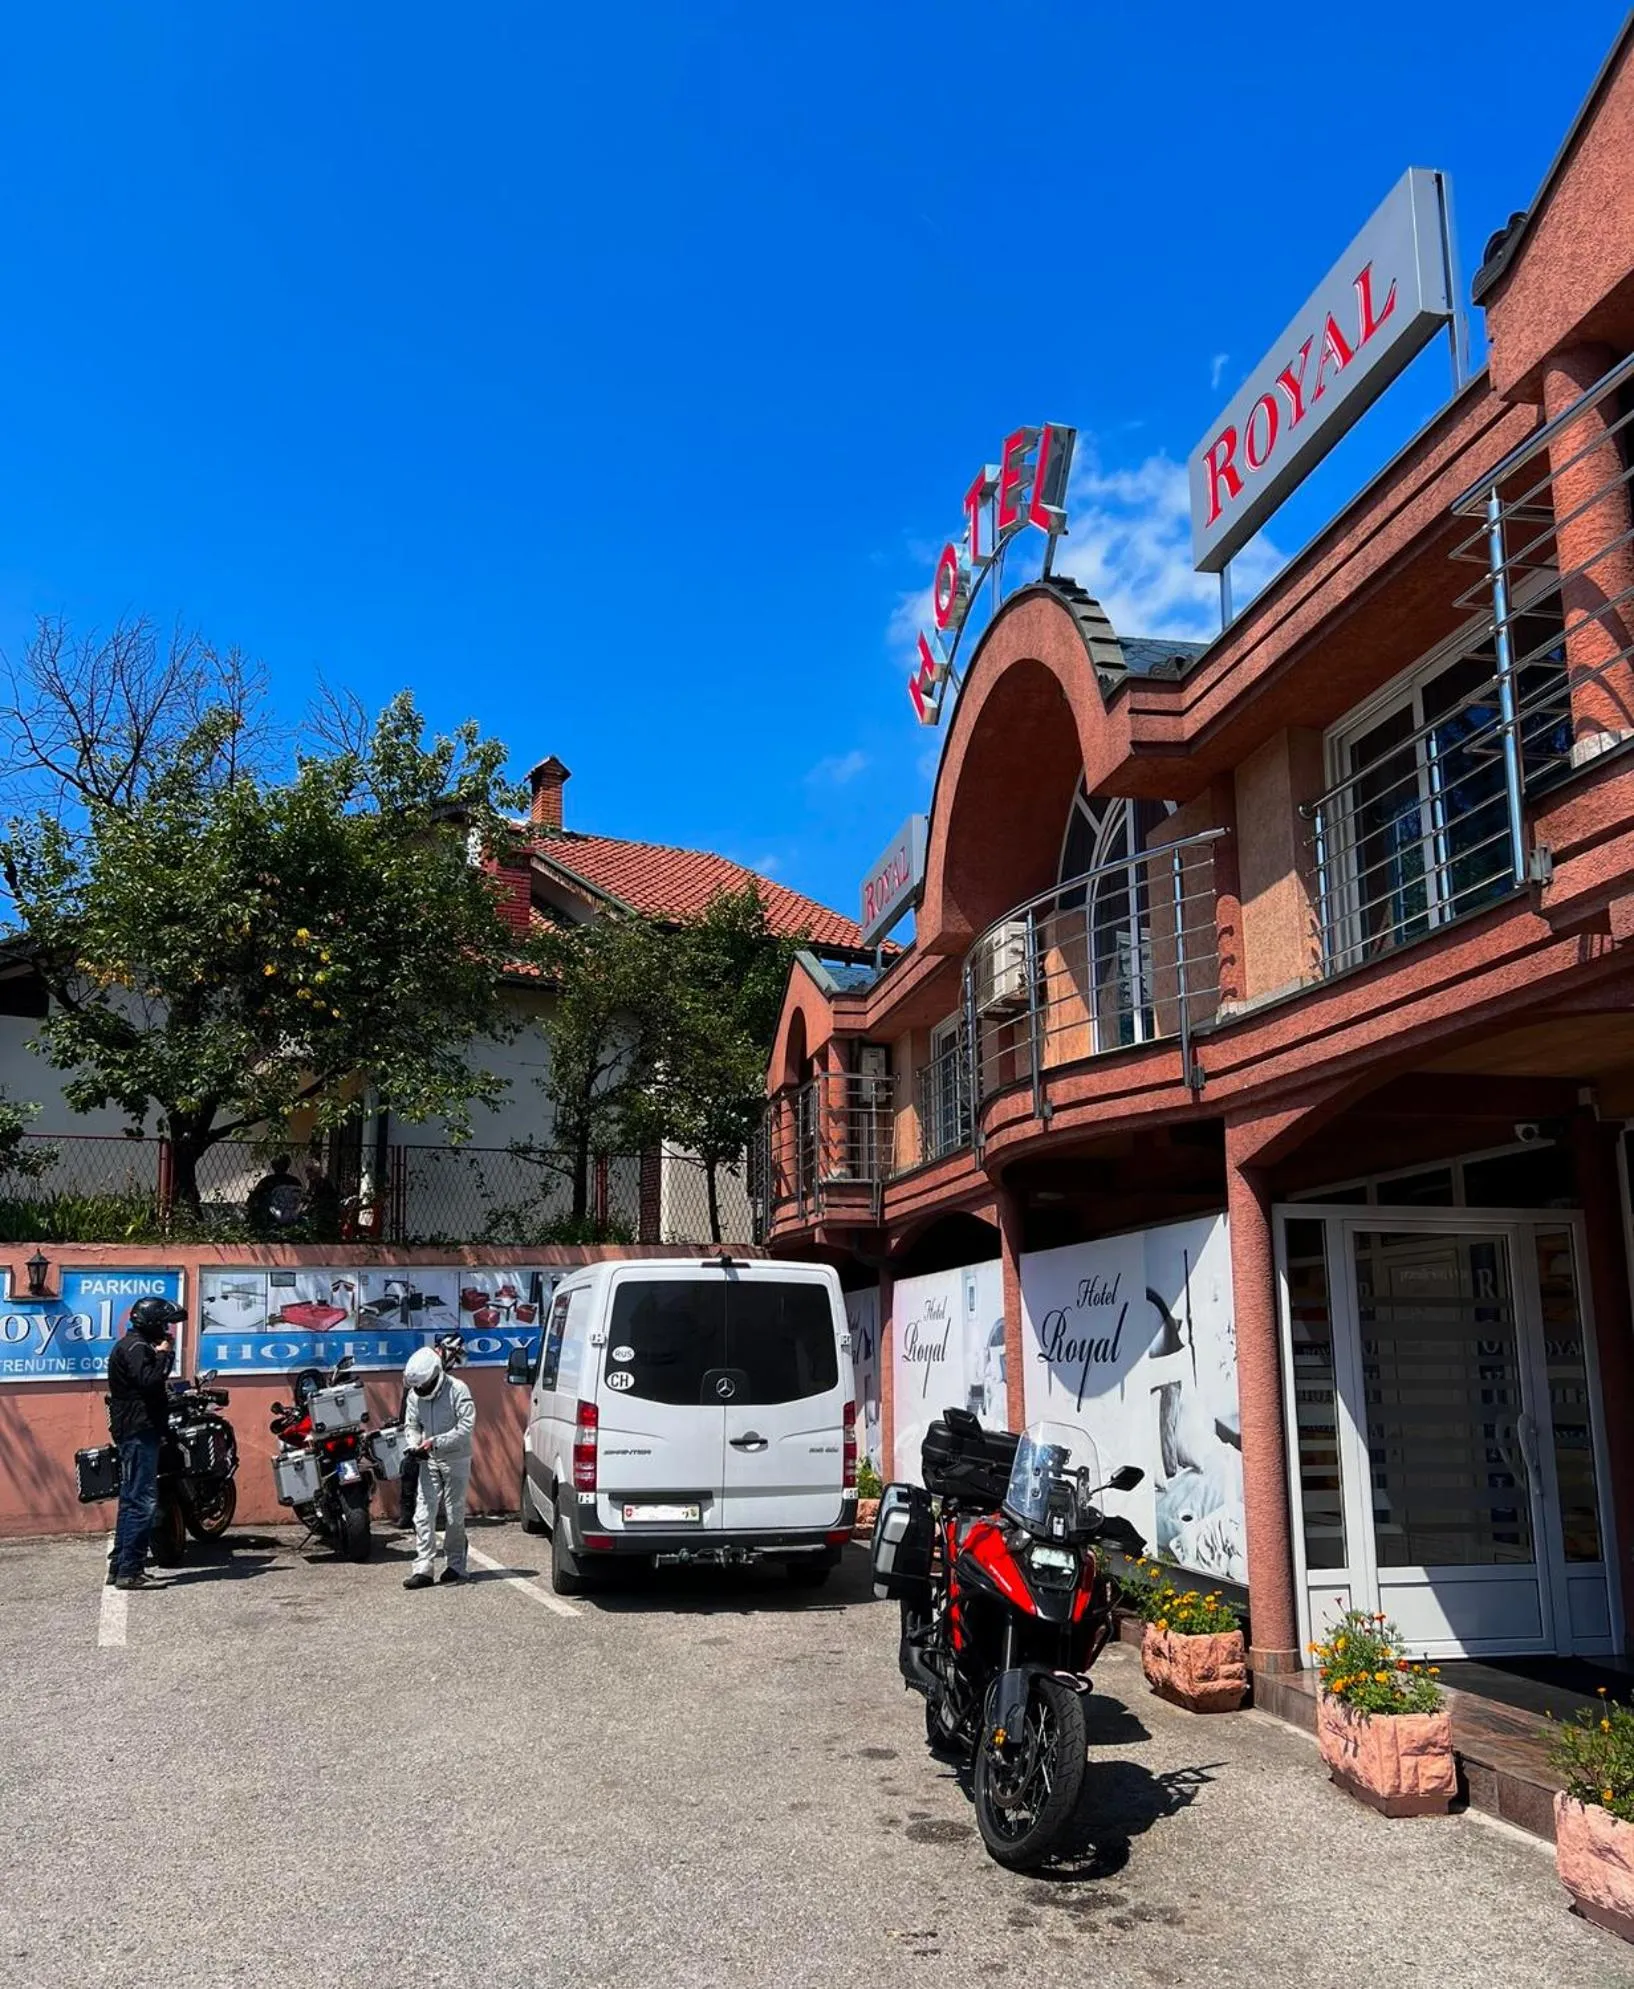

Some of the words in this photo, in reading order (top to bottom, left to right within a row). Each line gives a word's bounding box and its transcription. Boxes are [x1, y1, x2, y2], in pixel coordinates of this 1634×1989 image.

[1202, 259, 1397, 528] ROYAL
[908, 422, 1066, 725] HOTEL
[864, 845, 910, 929] ROYAL
[80, 1279, 166, 1295] PARKING
[923, 1295, 948, 1321] Hotel
[1076, 1272, 1121, 1309] Hotel
[216, 1340, 403, 1361] HOTEL
[611, 1373, 629, 1387] CH
[902, 1317, 951, 1399] Royal
[1038, 1301, 1129, 1413] Royal
